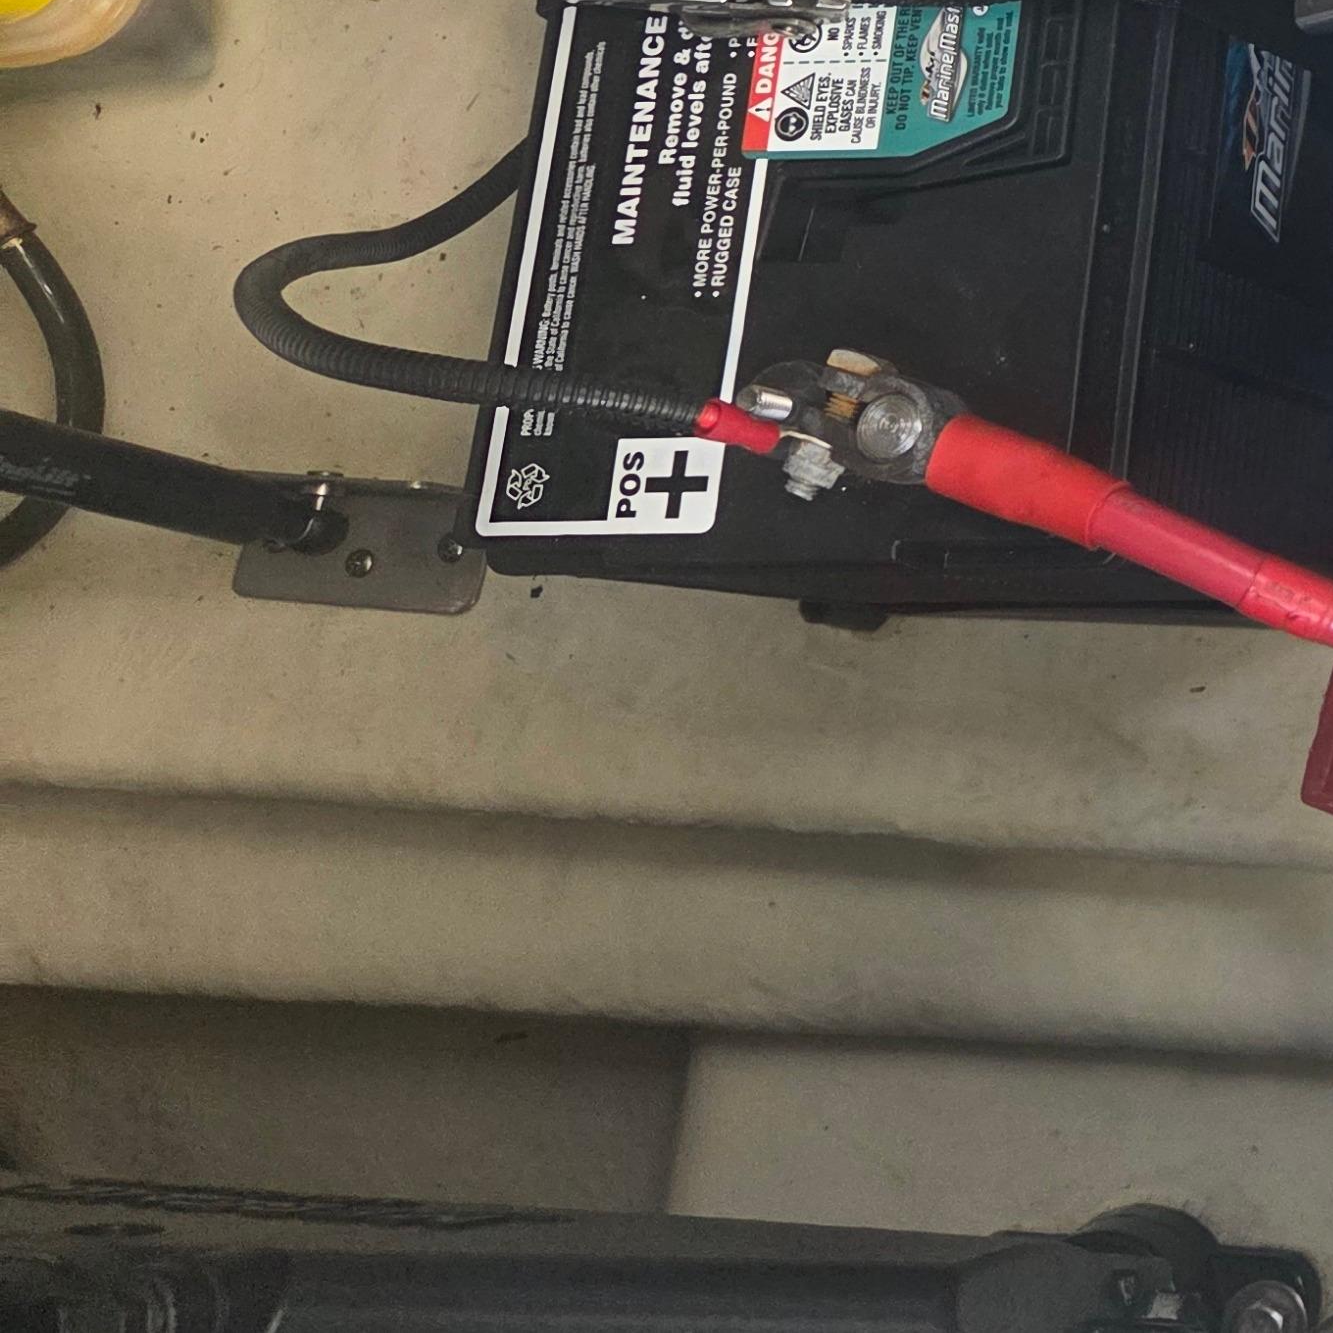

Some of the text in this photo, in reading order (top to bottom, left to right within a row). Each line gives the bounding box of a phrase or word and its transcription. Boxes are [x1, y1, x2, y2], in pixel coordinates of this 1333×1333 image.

[826, 26, 841, 41] NO
[840, 13, 857, 51] SPARKS
[855, 15, 872, 50] FLAMES
[870, 9, 888, 50] SMOKING
[610, 14, 668, 245] MAINTENANCE
[657, 71, 688, 164] Remove
[680, 78, 707, 148] levels
[808, 71, 832, 141] SHIELD EYES.
[823, 77, 844, 134] EXPLOSIVE
[837, 97, 855, 132] GASES
[849, 65, 872, 144] CAUSE BLINDNESS
[884, 85, 900, 115] KEEP
[671, 154, 696, 207] fluid
[691, 71, 738, 287] MORE POWER-PER-POUND
[710, 165, 743, 287] RUGGED CASE
[614, 450, 645, 518] POS
